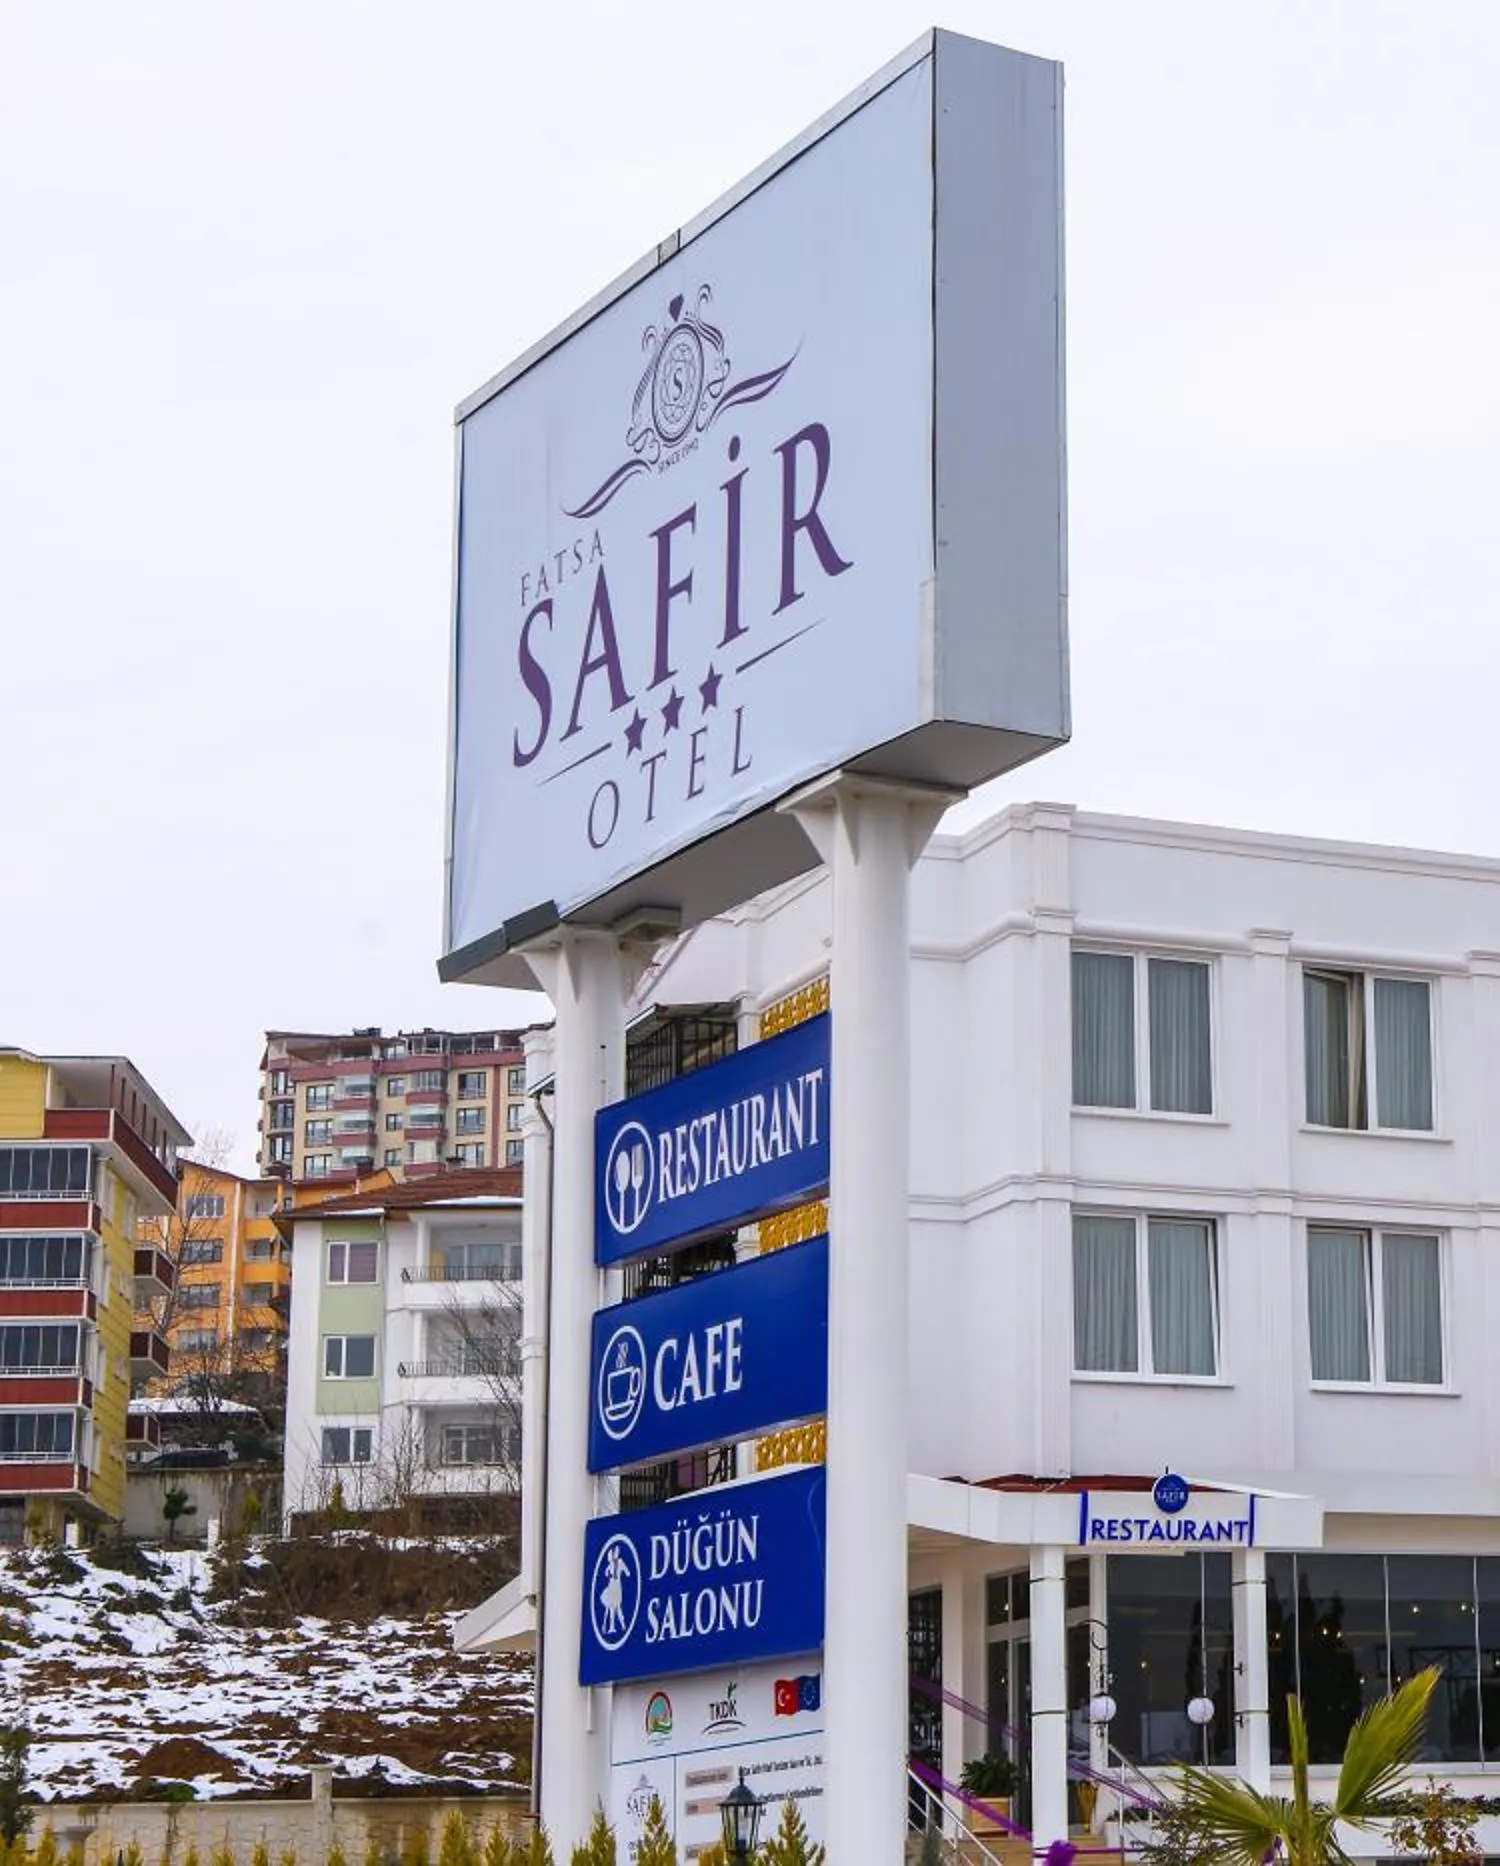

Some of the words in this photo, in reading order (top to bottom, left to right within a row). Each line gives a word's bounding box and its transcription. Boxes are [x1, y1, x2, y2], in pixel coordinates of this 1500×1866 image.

[513, 422, 855, 767] SAFİR
[521, 529, 606, 606] FATSA
[587, 705, 752, 849] OTEL
[657, 1068, 822, 1202] RESTAURANT
[653, 1317, 743, 1412] CAFE
[649, 1510, 759, 1580] DÜĞÜN
[1091, 1518, 1248, 1541] RESTAURANT
[645, 1579, 764, 1643] SALONU
